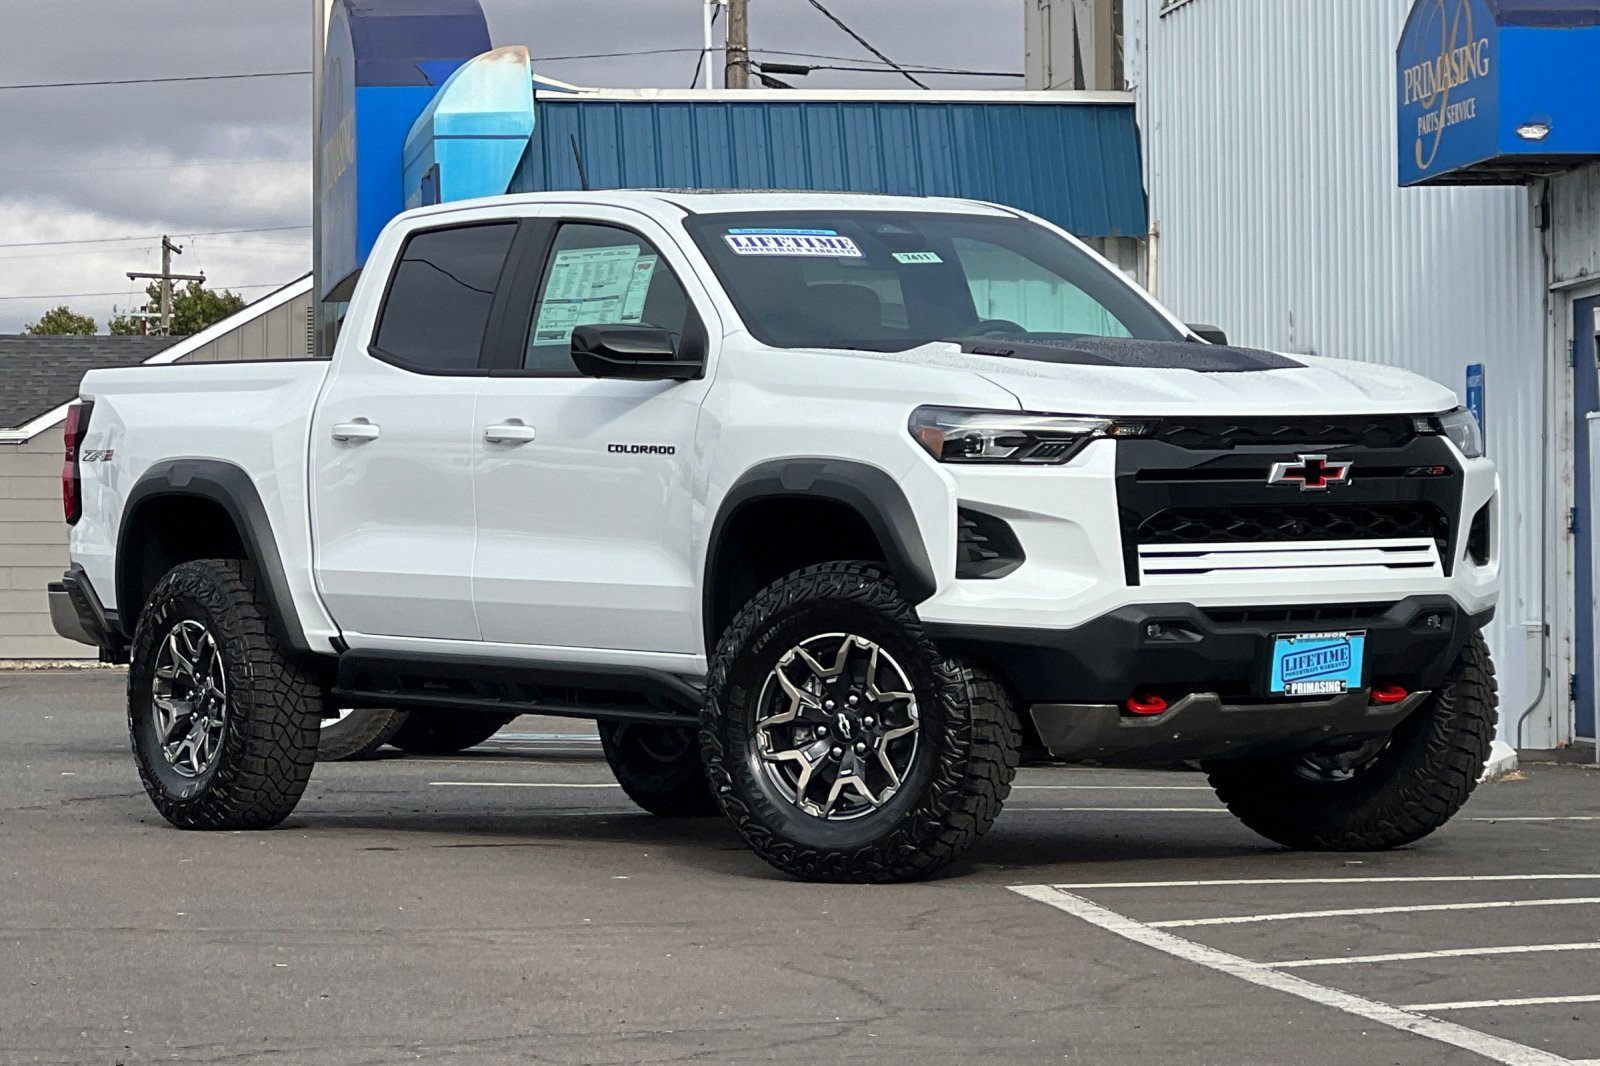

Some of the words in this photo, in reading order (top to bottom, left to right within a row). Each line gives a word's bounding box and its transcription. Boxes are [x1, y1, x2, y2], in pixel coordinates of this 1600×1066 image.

[1404, 38, 1489, 105] PRIMASING
[1417, 111, 1438, 137] PARTS
[1446, 98, 1476, 126] SERVICE
[730, 236, 854, 249] LIFETIME
[82, 450, 114, 462] ZR2
[608, 444, 675, 455] COLORADO
[1407, 466, 1445, 475] ZR2
[1295, 631, 1347, 640] LEBANON
[1285, 647, 1348, 672] LIFETIME
[1291, 681, 1341, 694] PRIMASING
